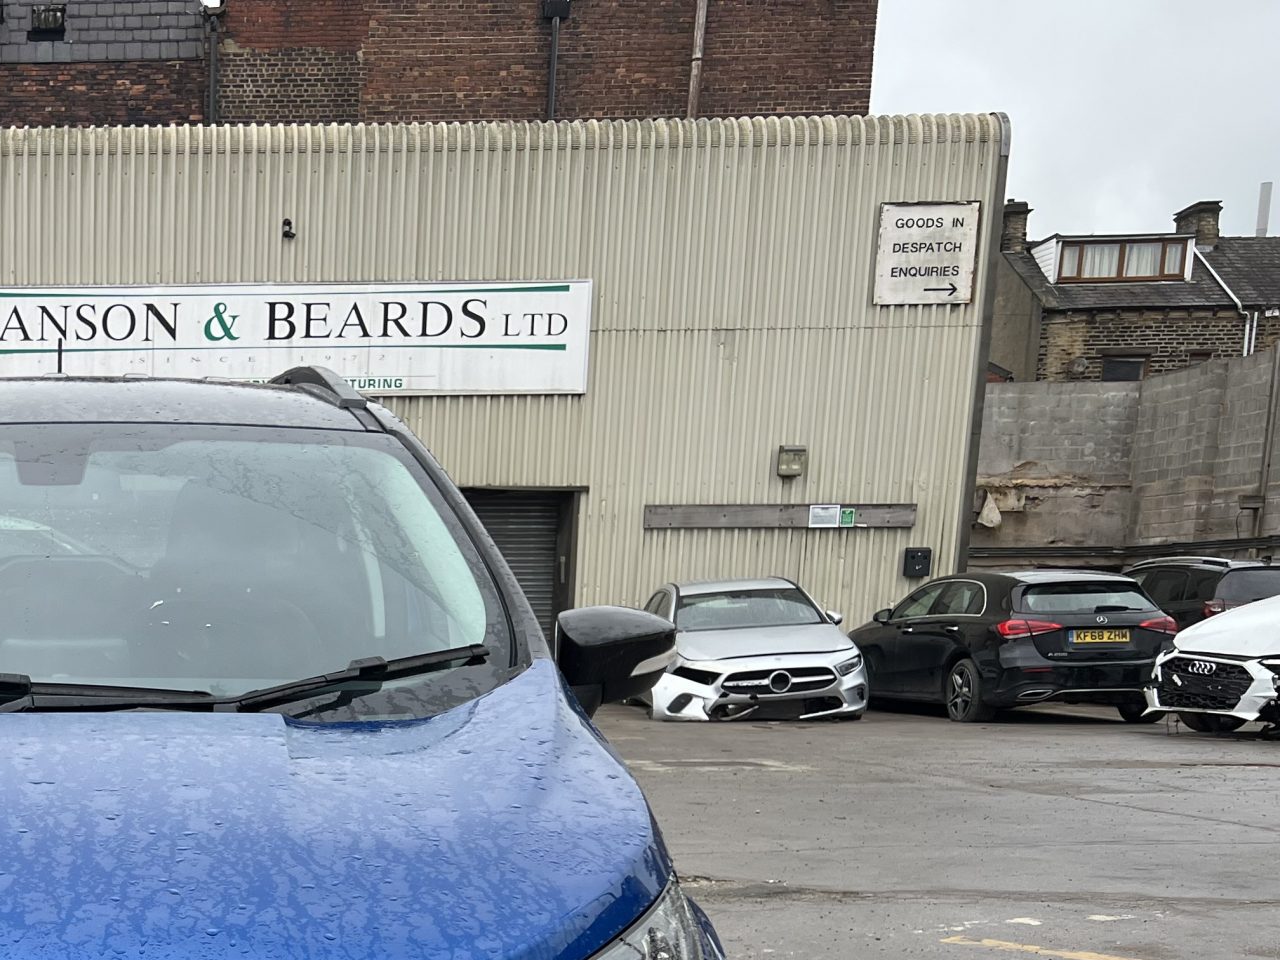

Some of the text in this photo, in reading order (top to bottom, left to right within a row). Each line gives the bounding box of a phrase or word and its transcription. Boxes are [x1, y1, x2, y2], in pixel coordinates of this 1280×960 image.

[895, 217, 965, 229] GOODS IN
[892, 242, 962, 254] DESPATCH
[890, 265, 960, 278] ENQUIRIES
[203, 302, 241, 342] &
[264, 299, 488, 341] BEARDS
[502, 312, 569, 337] LTD
[138, 356, 256, 364] SINCE
[1076, 630, 1104, 641] KF68
